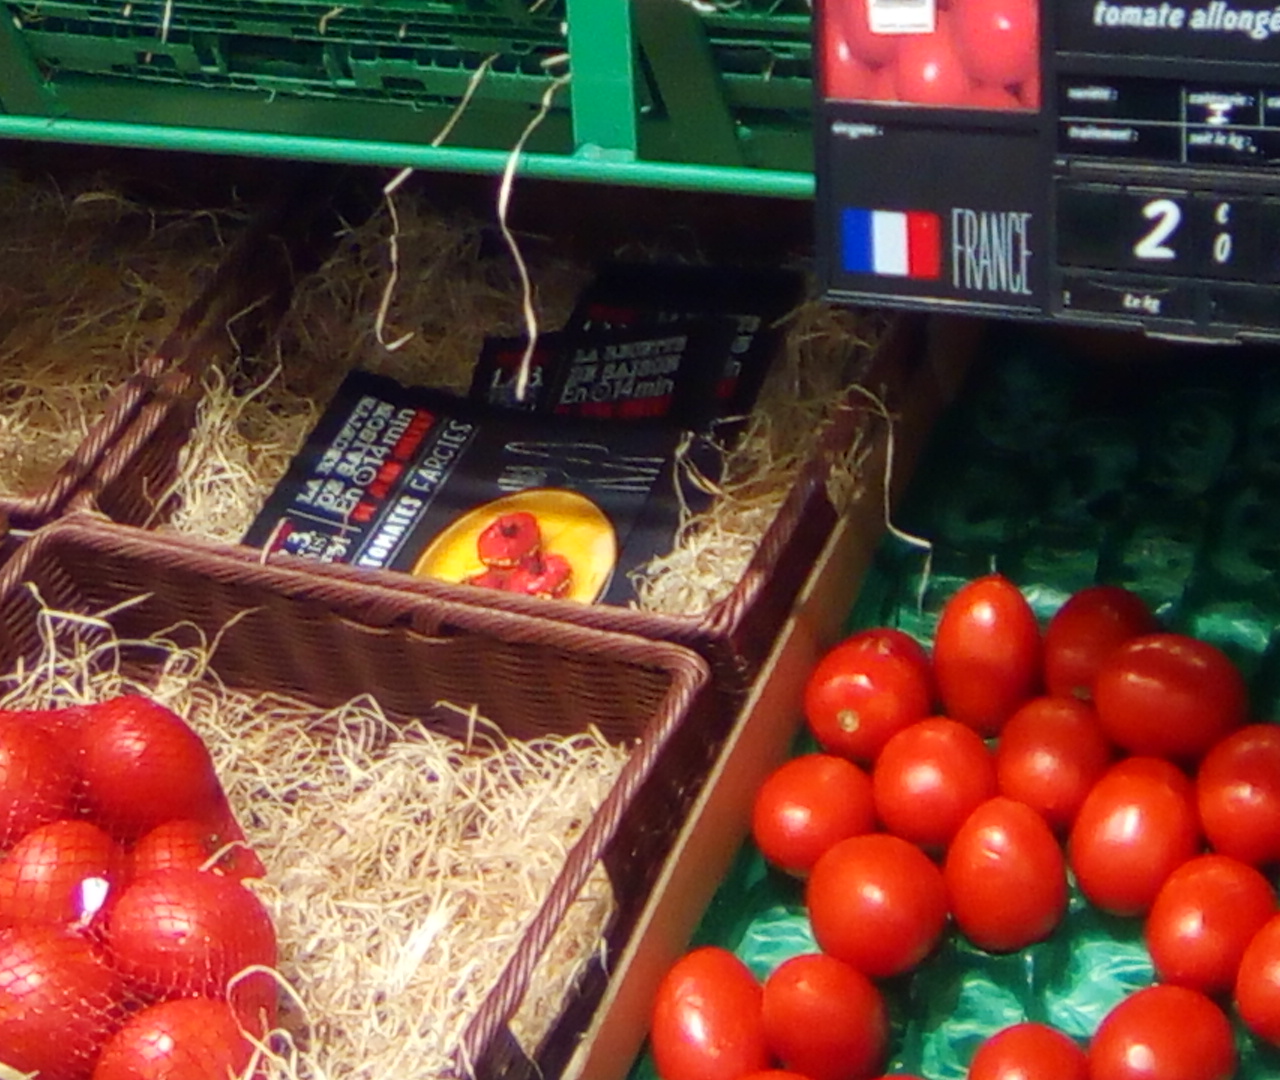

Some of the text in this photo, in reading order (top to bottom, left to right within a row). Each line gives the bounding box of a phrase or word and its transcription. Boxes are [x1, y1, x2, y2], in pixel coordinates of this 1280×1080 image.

[1093, 0, 1186, 29] tomate
[950, 207, 1033, 297] FRANCE
[358, 414, 474, 574] TOMATES FARCIES
